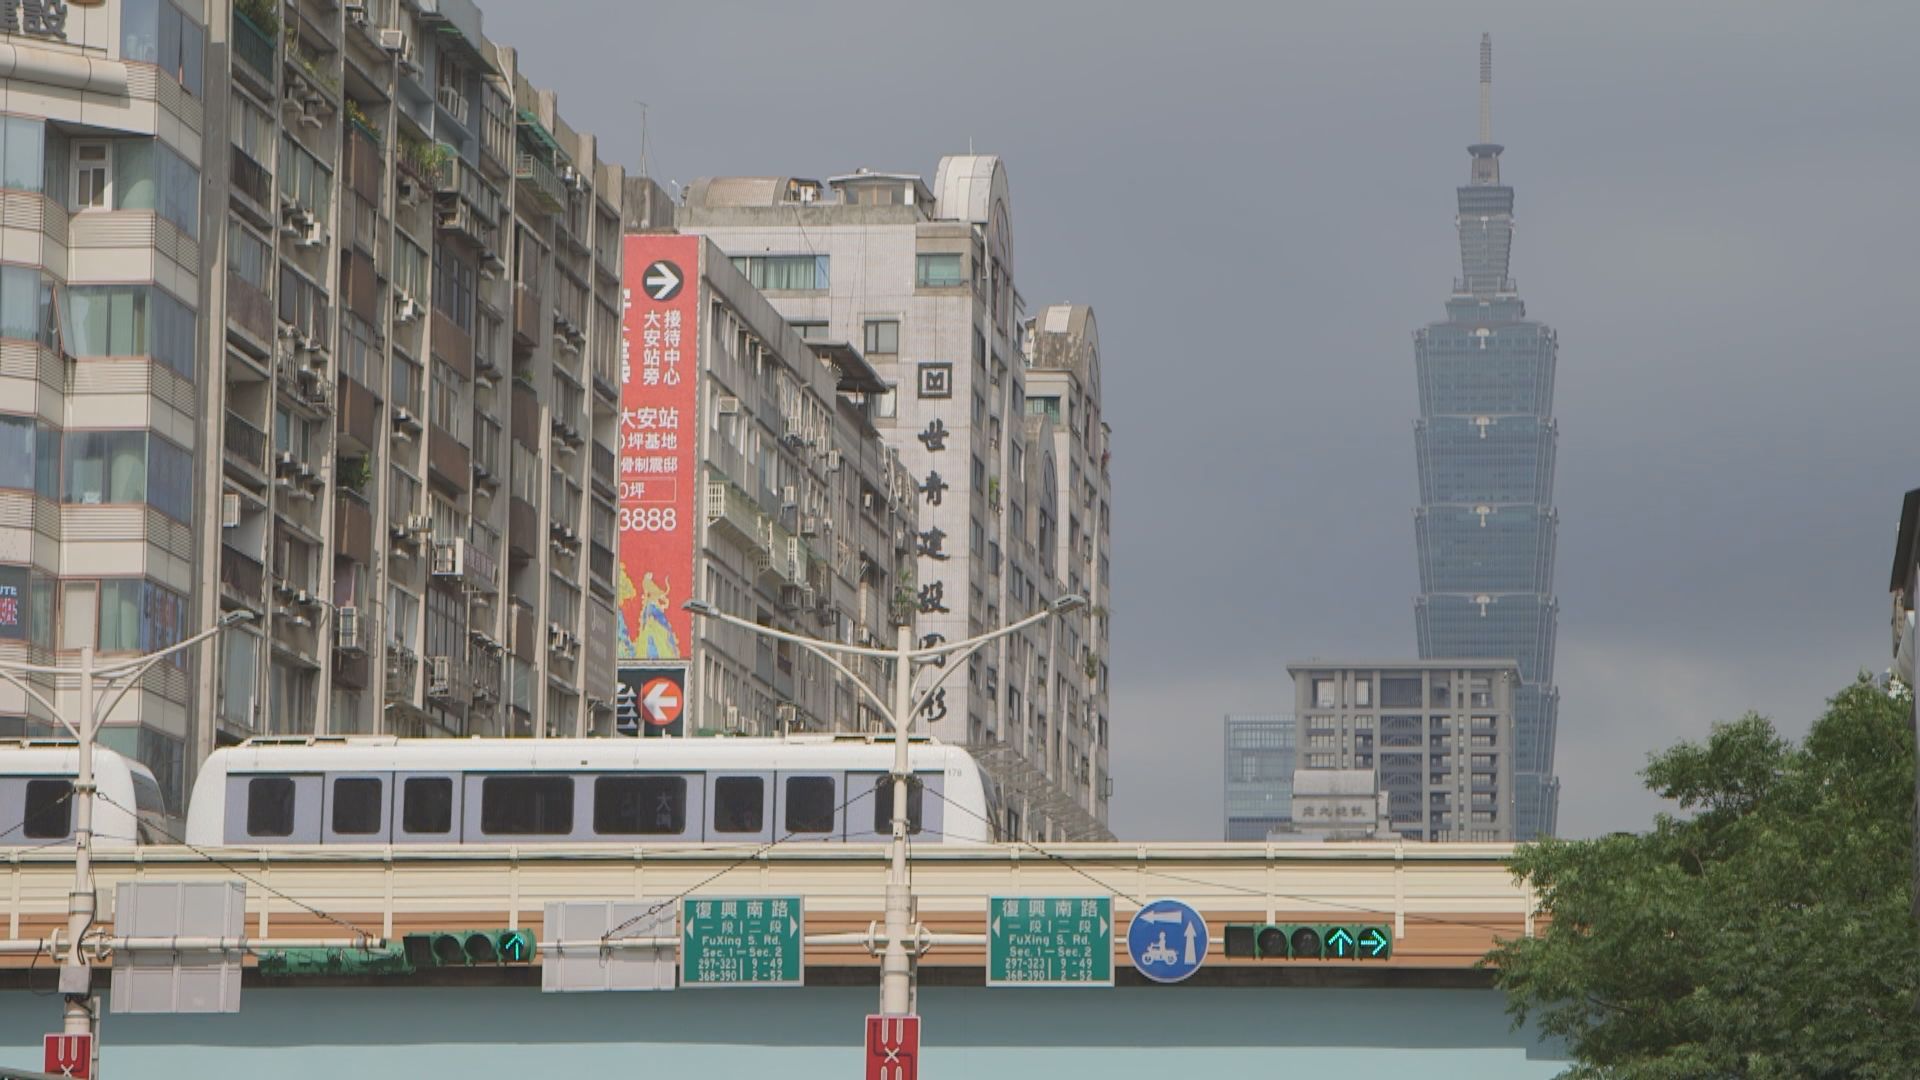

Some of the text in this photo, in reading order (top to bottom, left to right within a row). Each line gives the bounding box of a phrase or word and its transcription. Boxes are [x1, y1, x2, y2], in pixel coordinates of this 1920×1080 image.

[643, 309, 661, 385] 大安站旁
[663, 309, 681, 385] 接待中心
[620, 406, 679, 429] 大安站
[695, 900, 789, 919] 復興南路
[1002, 899, 1098, 917] 復興南路
[701, 934, 782, 948] FuXing S. Rd.
[1008, 934, 1091, 946] FuXing S. Rd.
[702, 948, 726, 957] Sec.
[749, 947, 772, 957] Sec.
[774, 947, 782, 957] 2
[1009, 946, 1033, 957] Sec.
[1057, 946, 1081, 957] Sec.
[1084, 946, 1092, 957] 2
[698, 958, 737, 970] 297-323
[1005, 958, 1045, 969] 297-323
[698, 970, 737, 981] 368-390
[1005, 970, 1045, 981] 368-390
